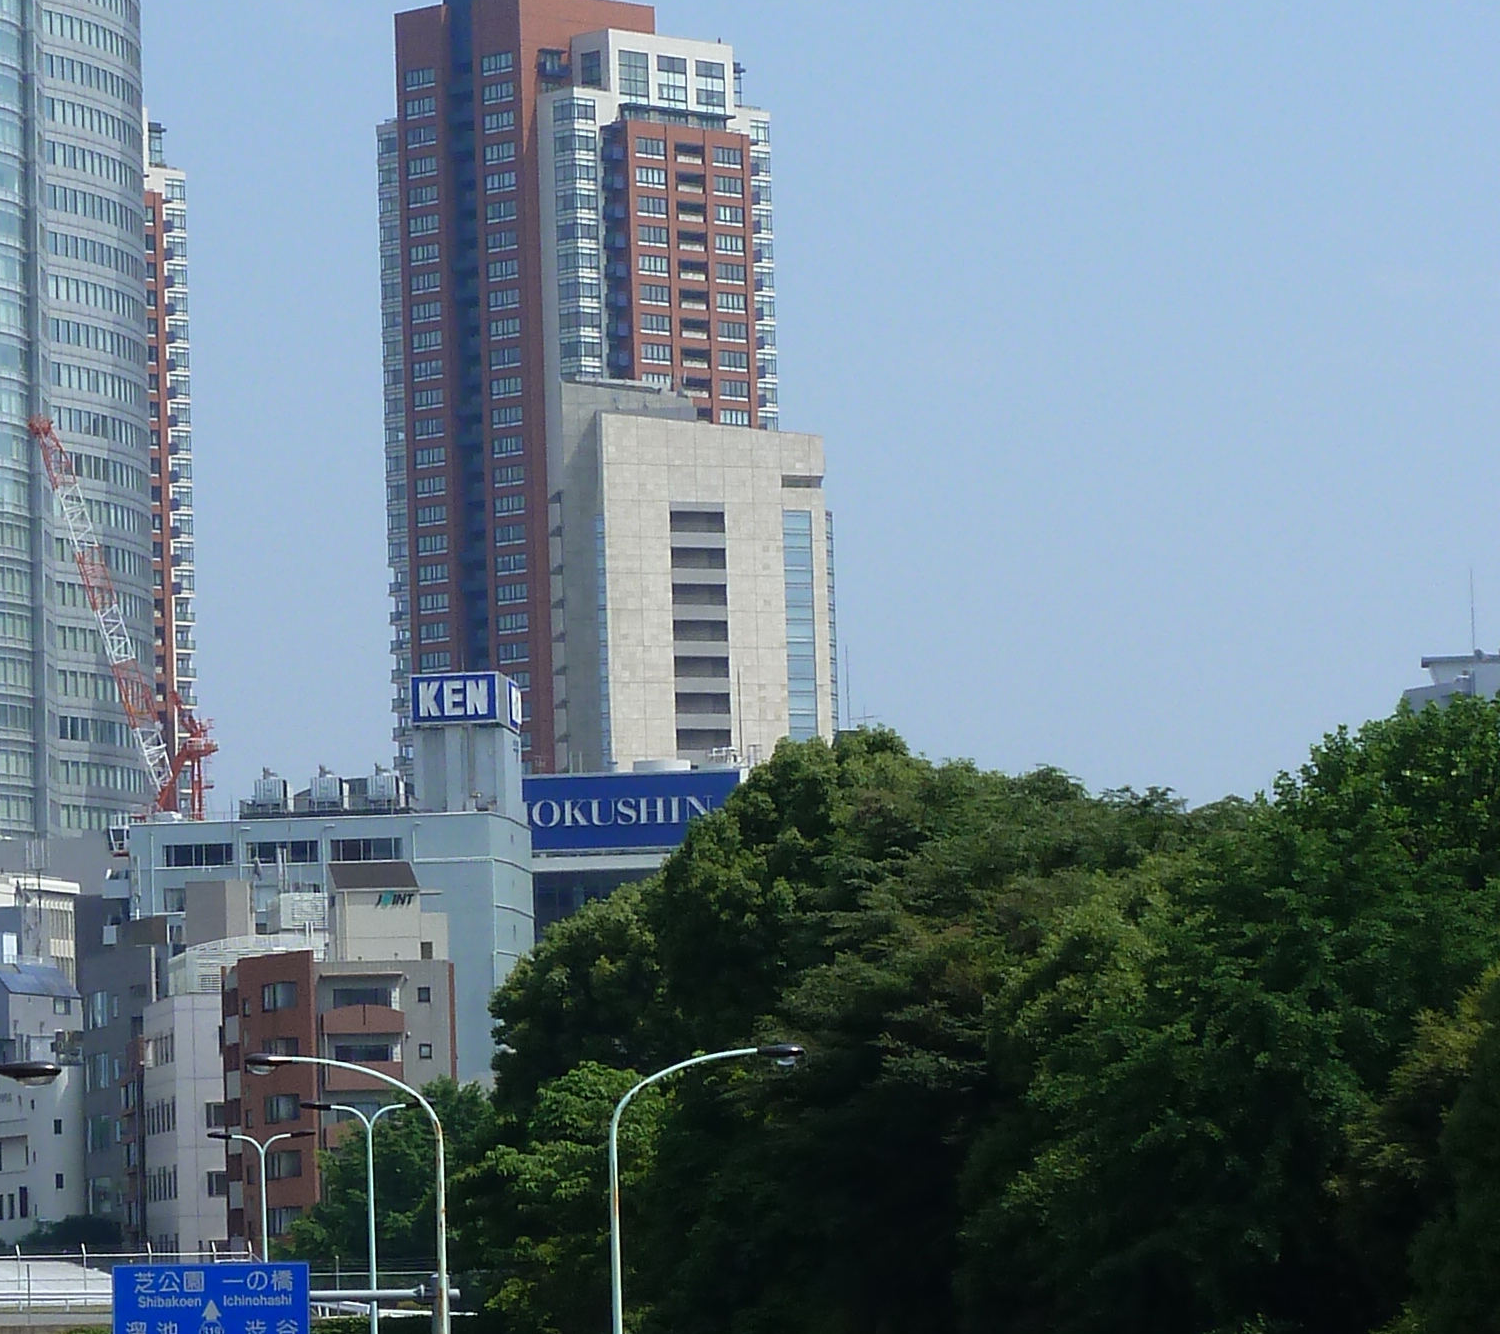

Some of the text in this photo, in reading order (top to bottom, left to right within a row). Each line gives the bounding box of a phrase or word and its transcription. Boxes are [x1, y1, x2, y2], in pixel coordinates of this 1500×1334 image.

[418, 679, 488, 717] KEN
[527, 795, 714, 828] OKUSHIN
[133, 1269, 294, 1294] 芝公園 一の橋
[137, 1294, 292, 1308] Shibakoen Ichinohashi
